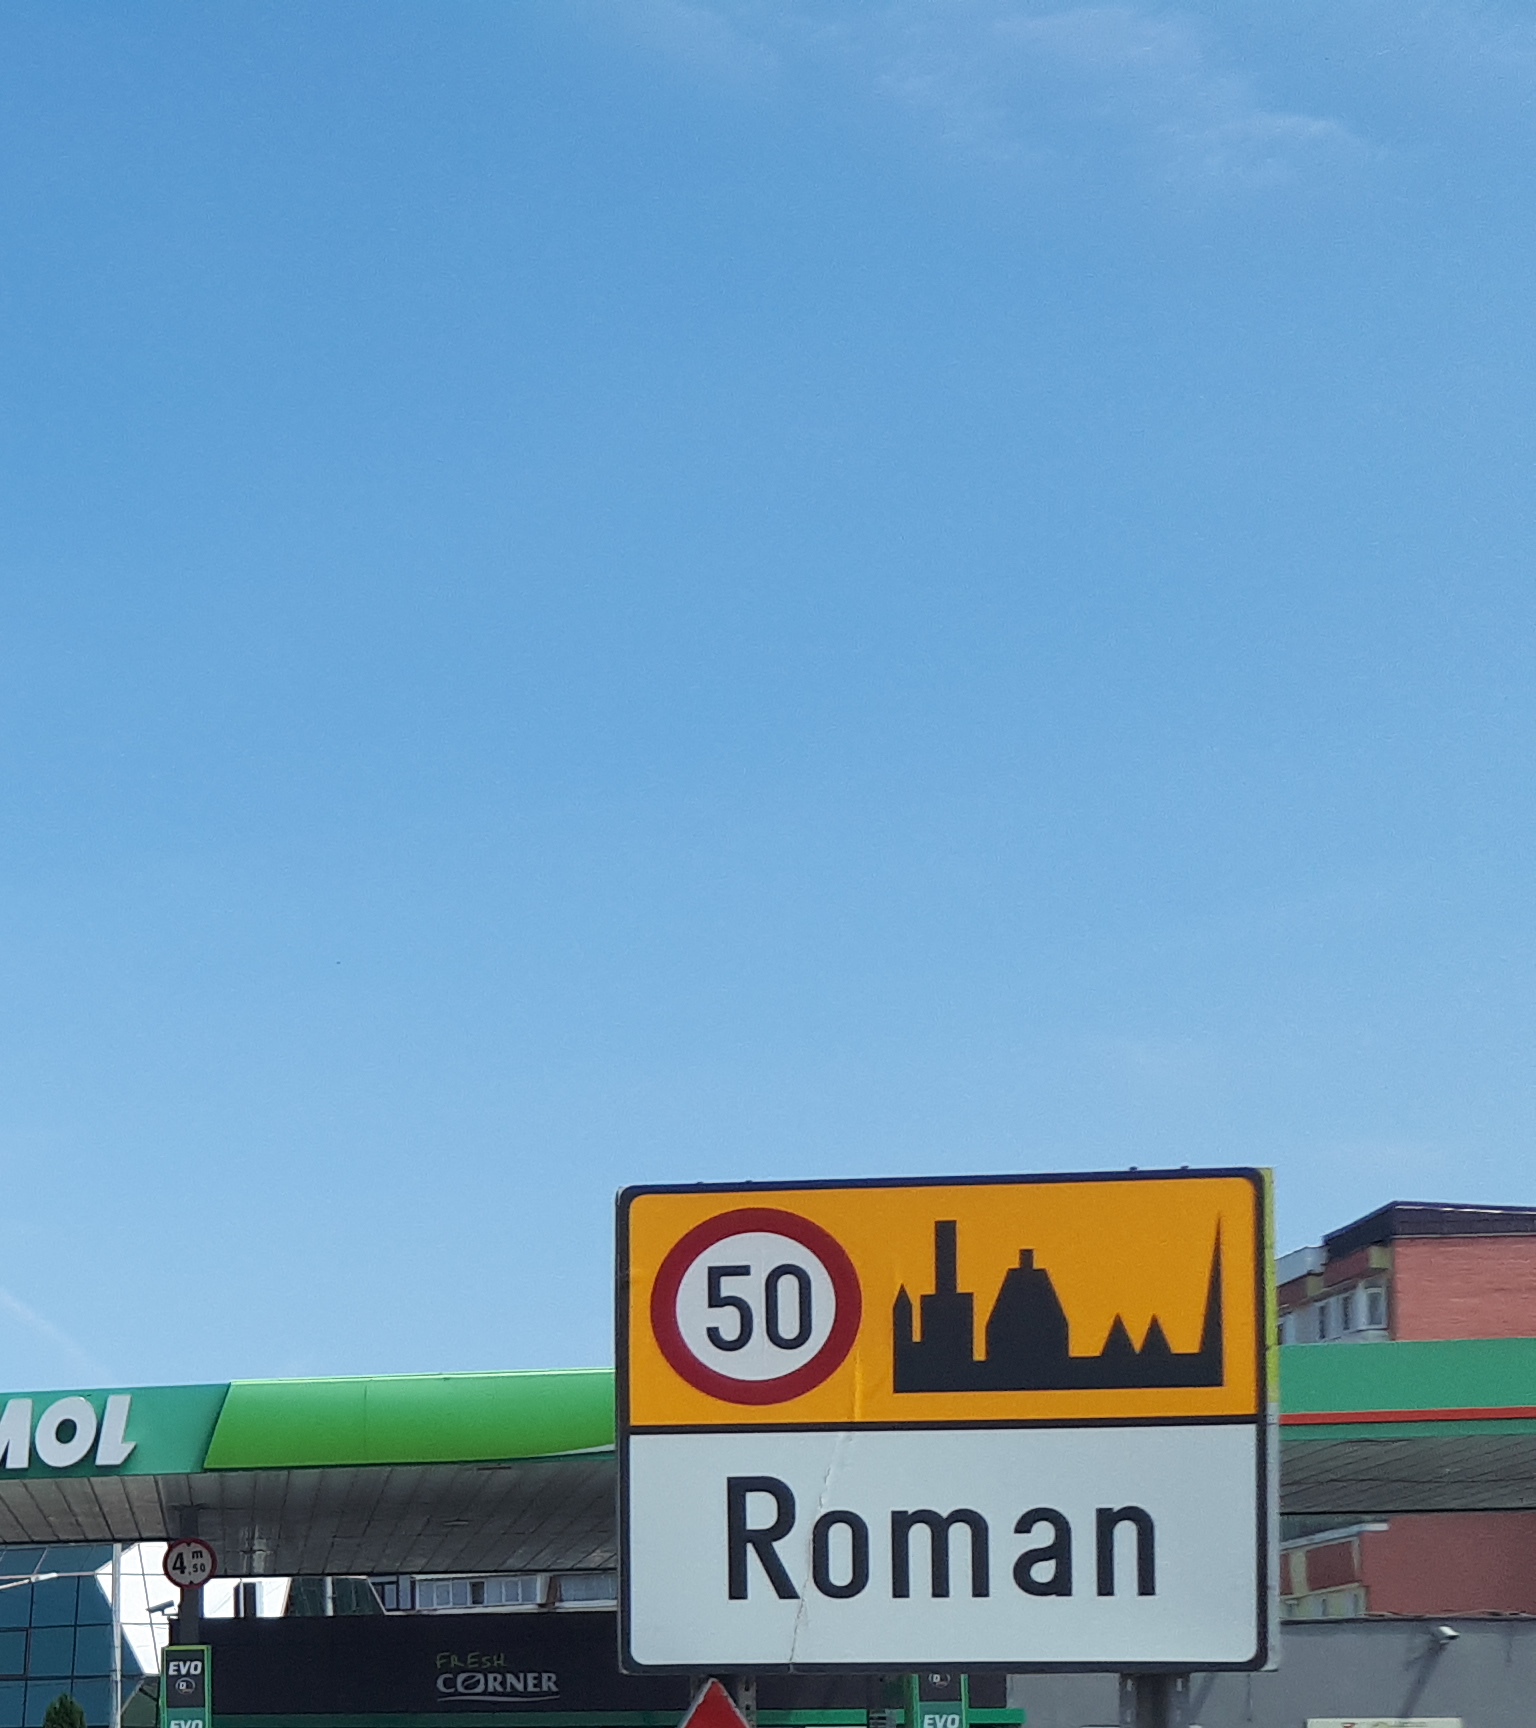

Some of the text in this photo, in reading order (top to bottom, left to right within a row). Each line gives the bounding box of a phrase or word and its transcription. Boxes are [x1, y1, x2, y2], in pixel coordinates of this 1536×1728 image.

[706, 1263, 813, 1352] 50
[727, 1475, 1157, 1600] Roman
[168, 1661, 202, 1675] EVO
[435, 1652, 507, 1668] FRESH
